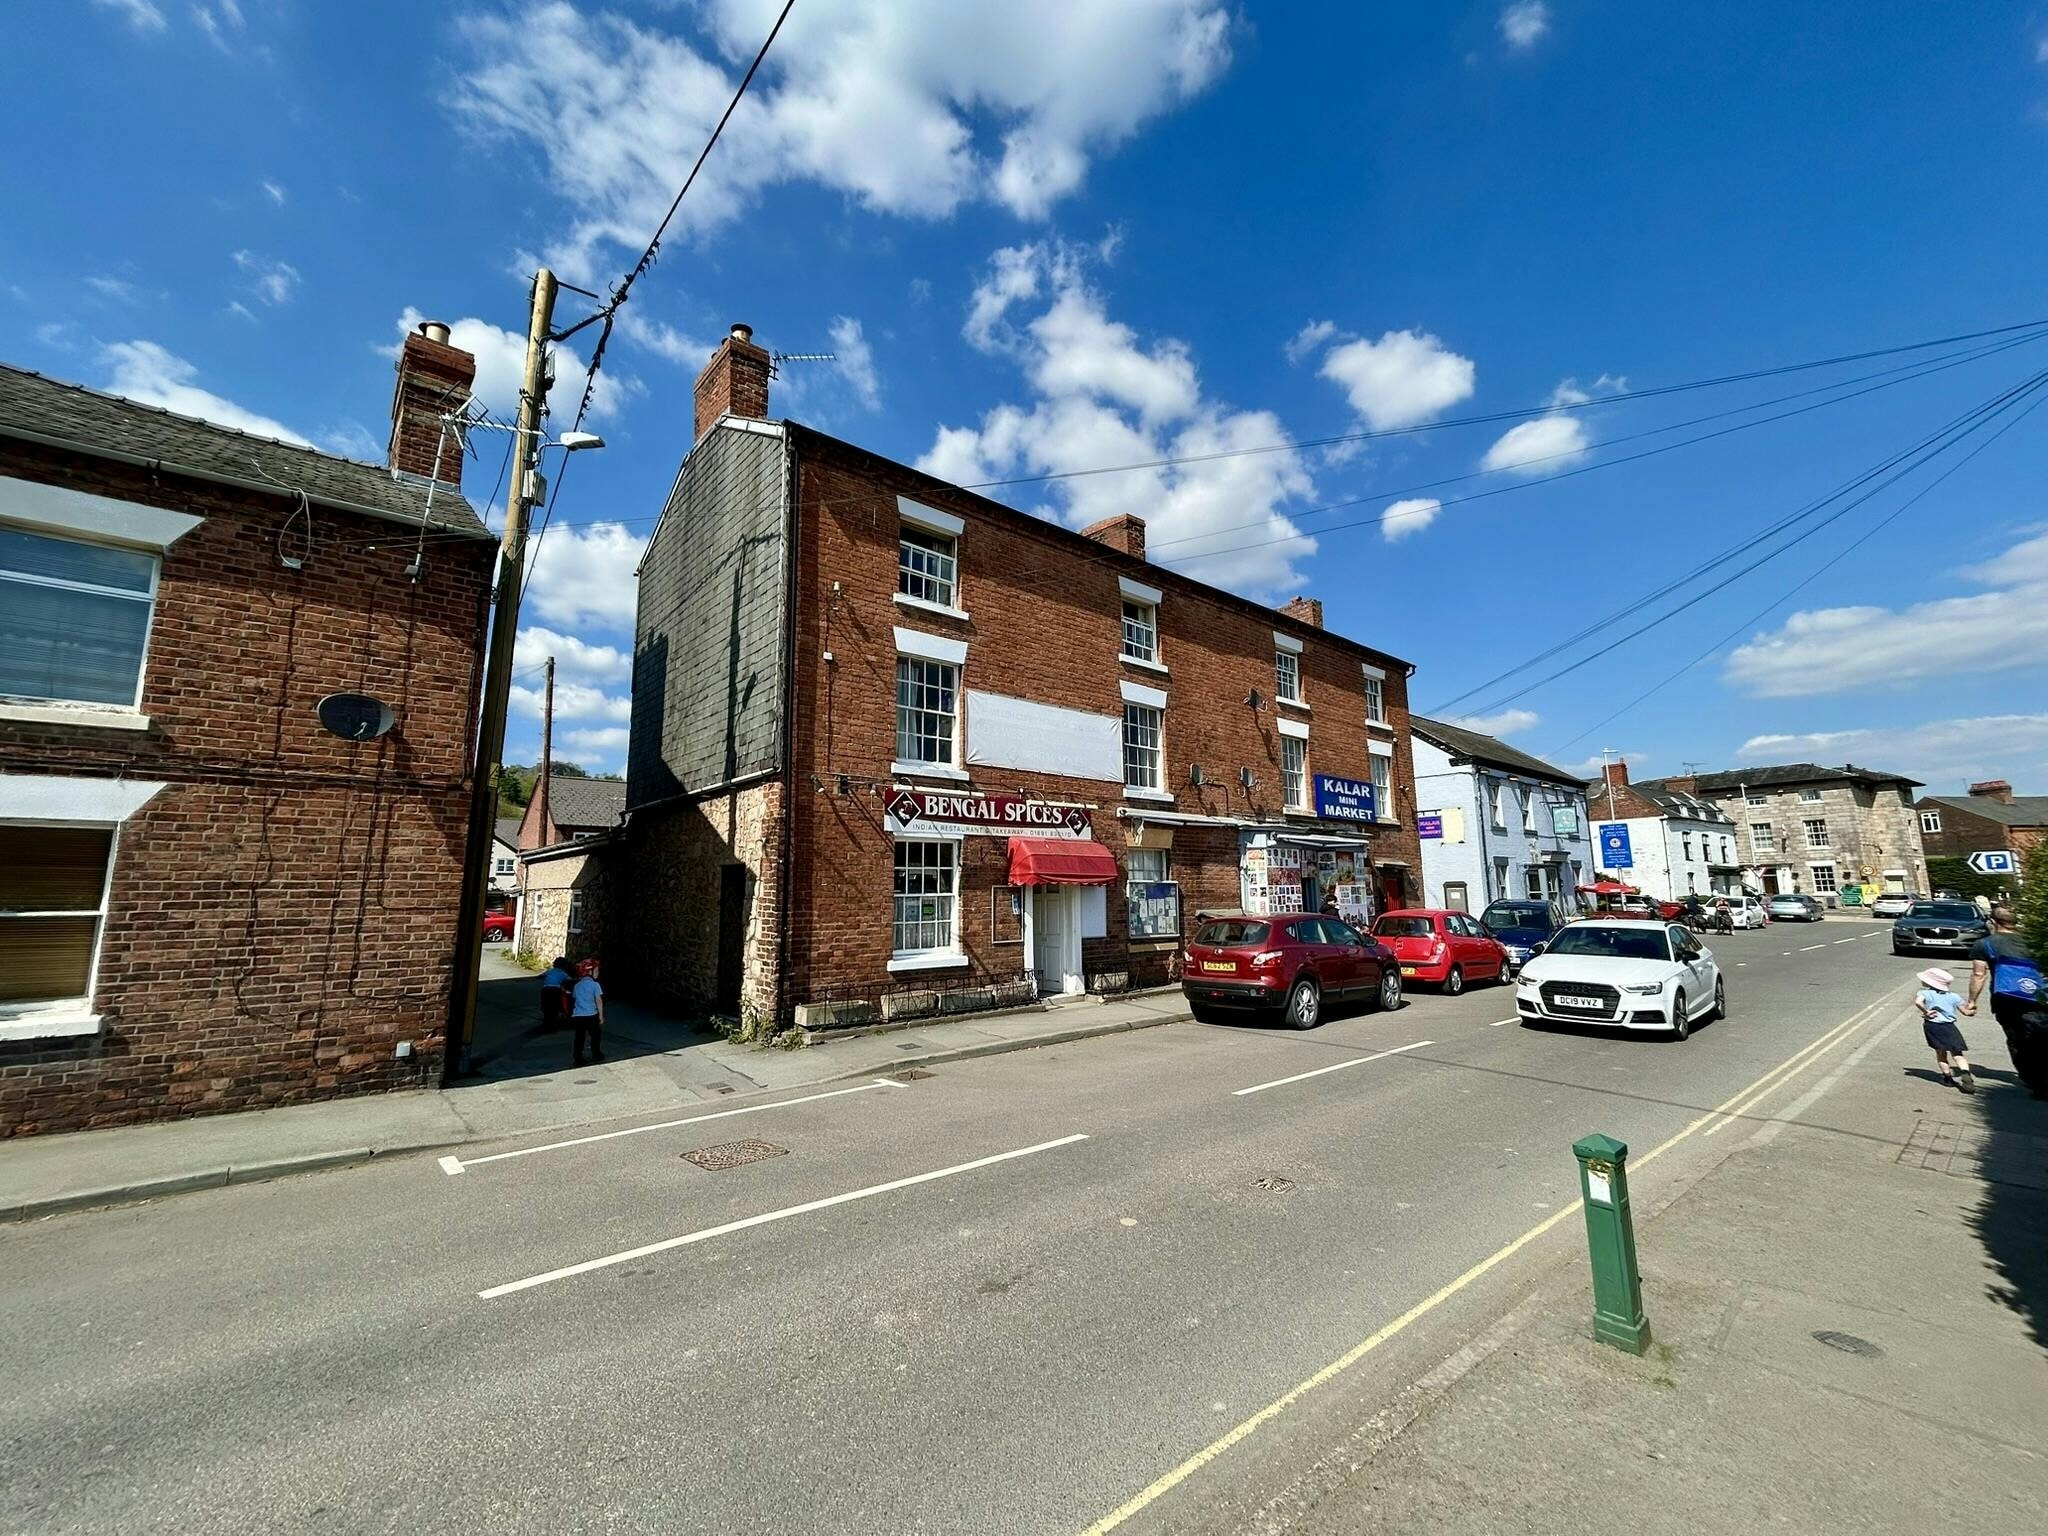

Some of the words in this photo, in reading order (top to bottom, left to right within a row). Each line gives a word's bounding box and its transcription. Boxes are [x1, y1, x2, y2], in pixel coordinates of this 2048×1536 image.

[1324, 779, 1371, 798] KALAR
[1338, 796, 1358, 806] MINI
[924, 795, 1001, 820] BENGAL
[1004, 802, 1063, 824] SPICES
[1324, 804, 1373, 820] MARKET
[912, 823, 938, 831] INDIAN
[940, 825, 984, 834] RESTAURANT
[992, 828, 1024, 836] TAKEAWAY
[1990, 855, 2004, 868] P
[1560, 996, 1578, 1005] DC19
